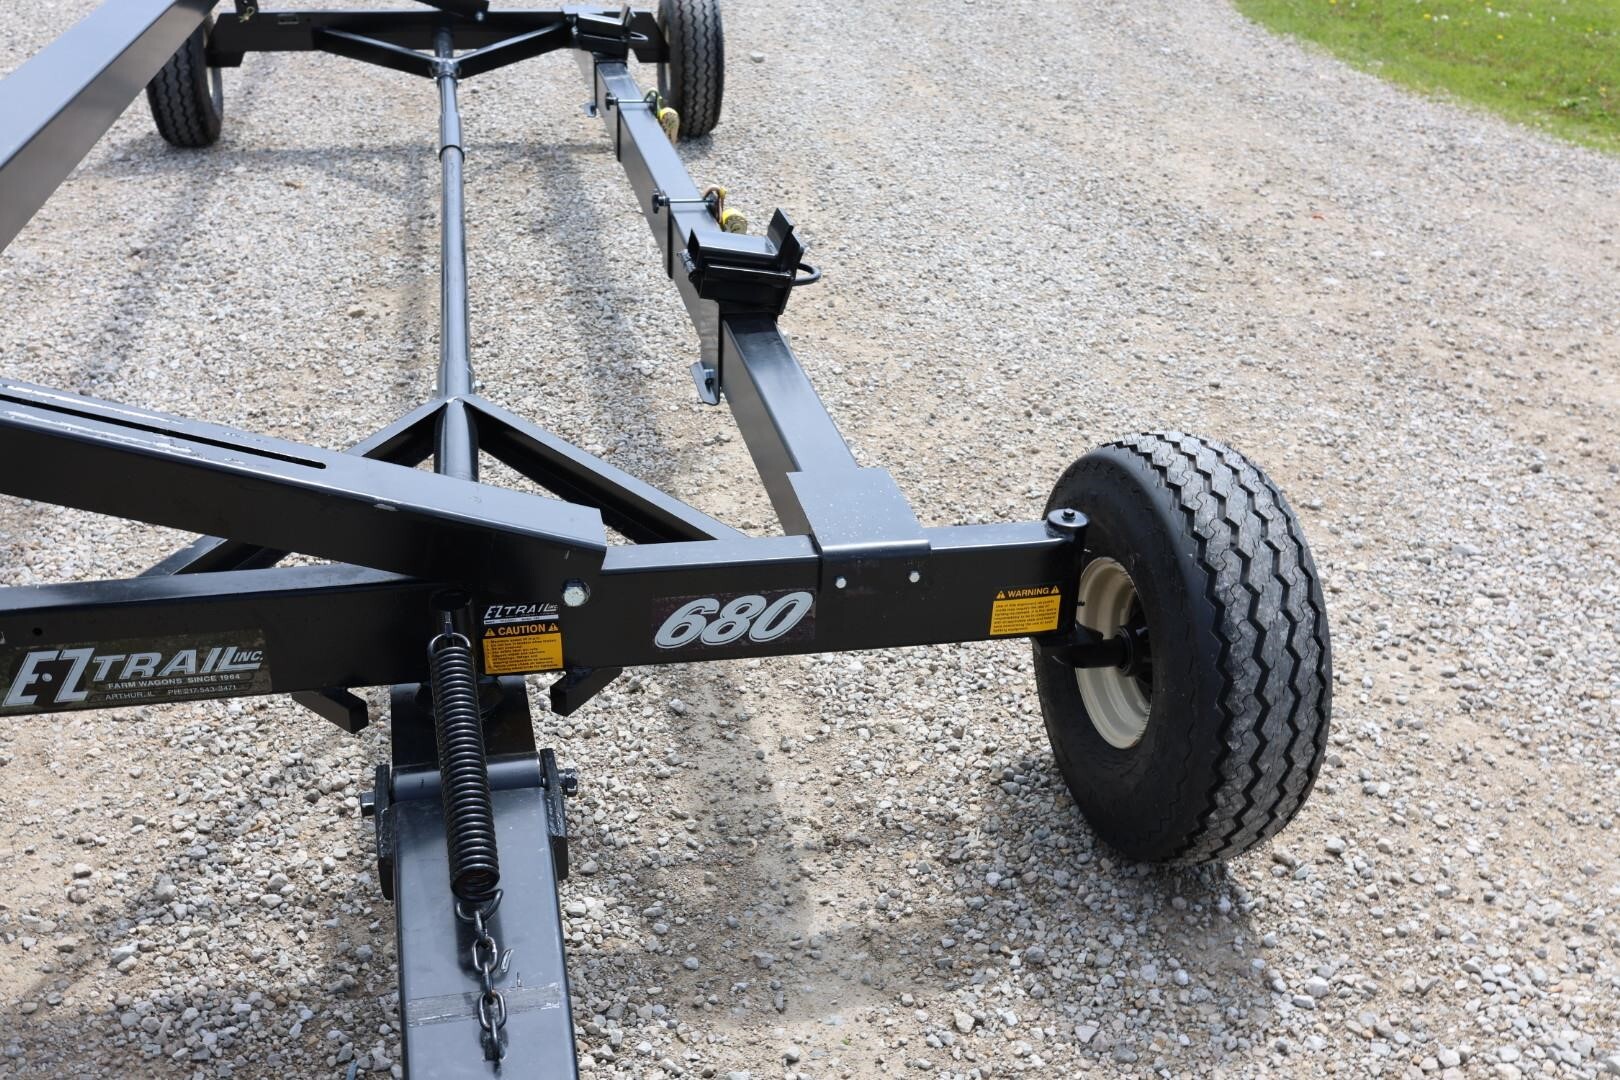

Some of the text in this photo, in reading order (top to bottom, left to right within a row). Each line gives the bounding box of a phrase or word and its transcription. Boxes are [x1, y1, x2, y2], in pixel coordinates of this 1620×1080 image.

[1007, 587, 1049, 598] WARNING
[654, 591, 814, 649] 680
[497, 623, 546, 636] CAUTION
[108, 681, 136, 690] FARM
[139, 678, 183, 688] WAGONS
[187, 675, 217, 684] SINCE
